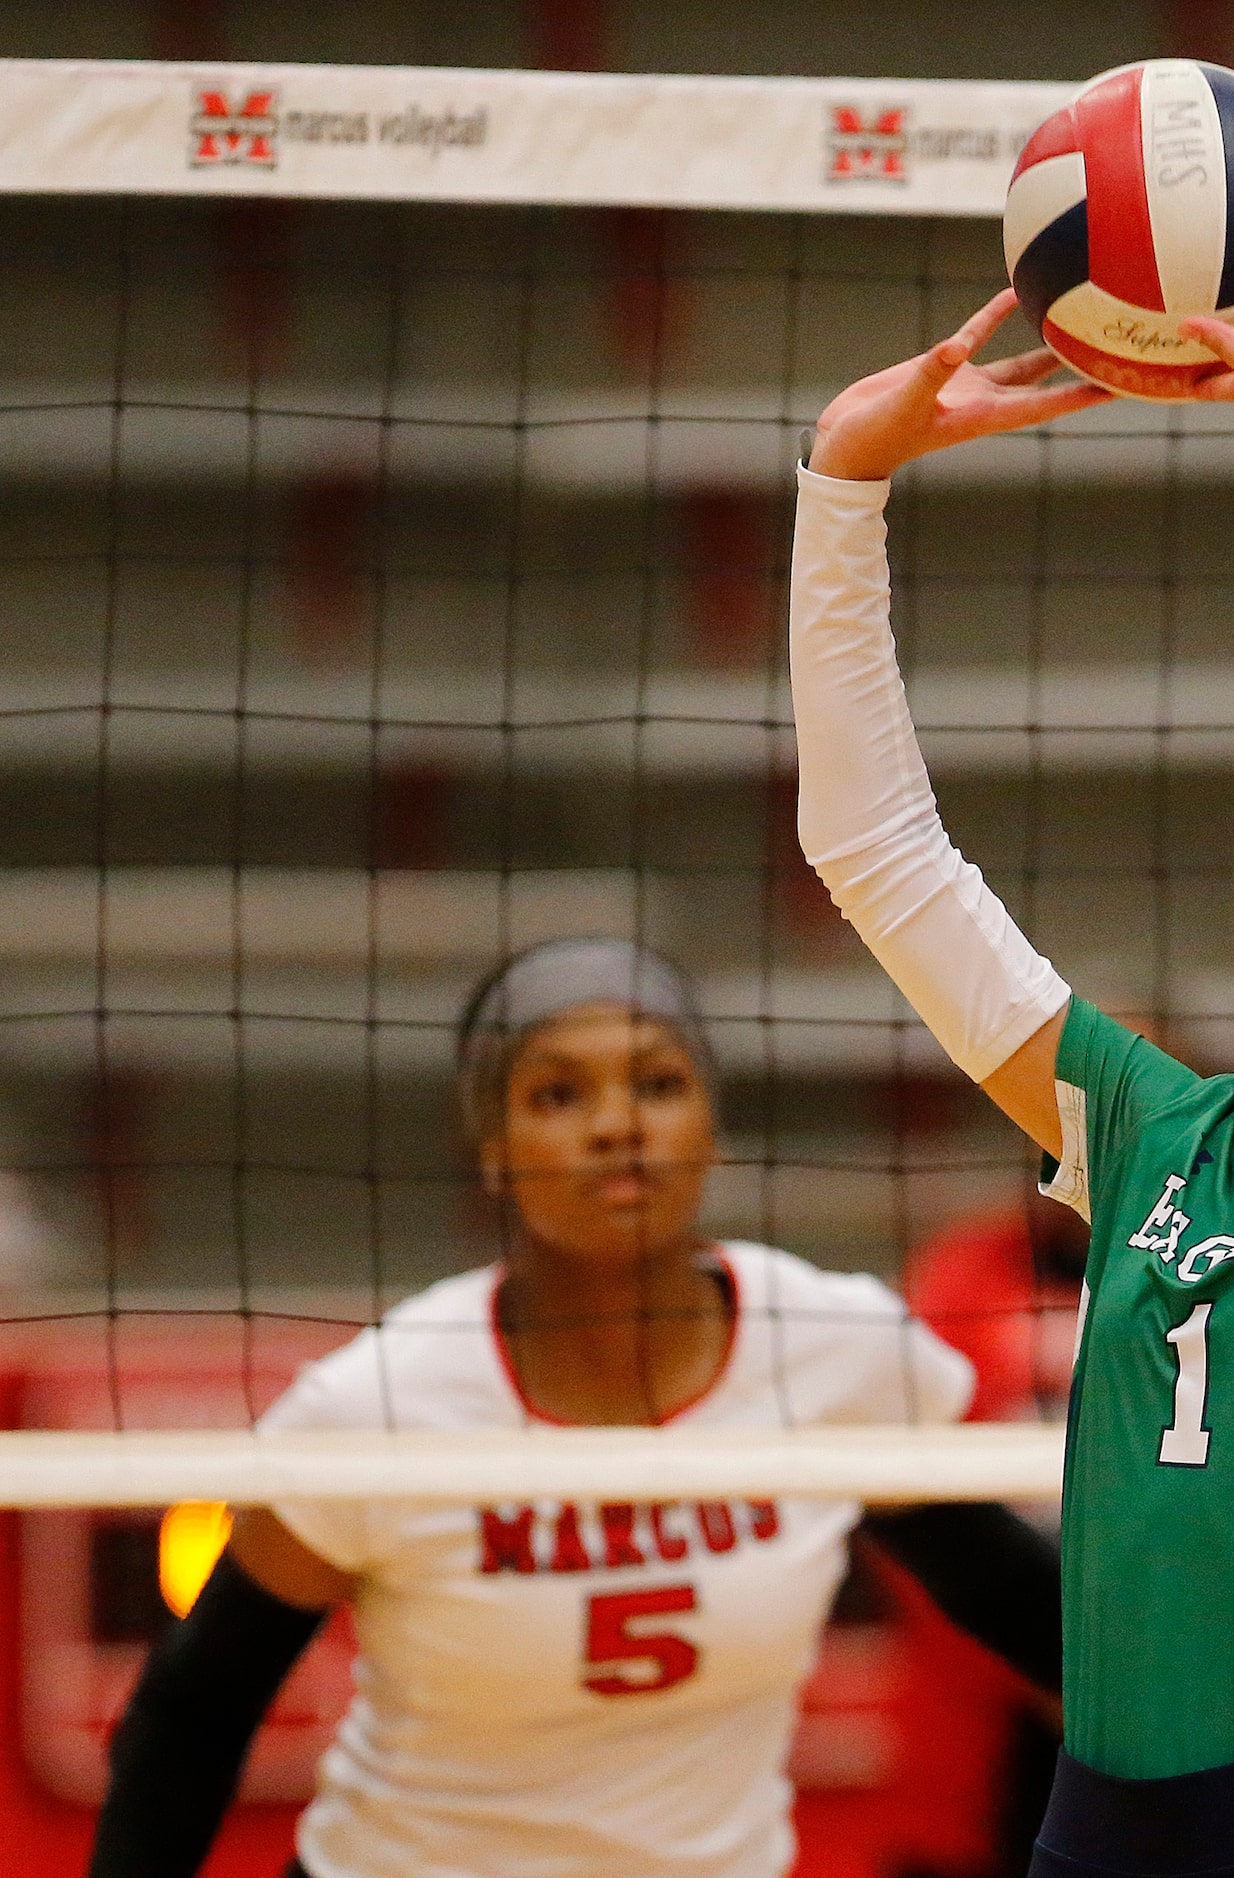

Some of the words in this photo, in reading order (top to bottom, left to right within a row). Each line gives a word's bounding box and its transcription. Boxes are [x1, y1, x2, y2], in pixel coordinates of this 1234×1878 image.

[284, 109, 368, 144] marcus
[378, 101, 489, 160] volleyball
[1153, 99, 1209, 188] MHS
[1104, 318, 1186, 352] Super
[1156, 1302, 1214, 1468] 1
[581, 1581, 700, 1696] 5
